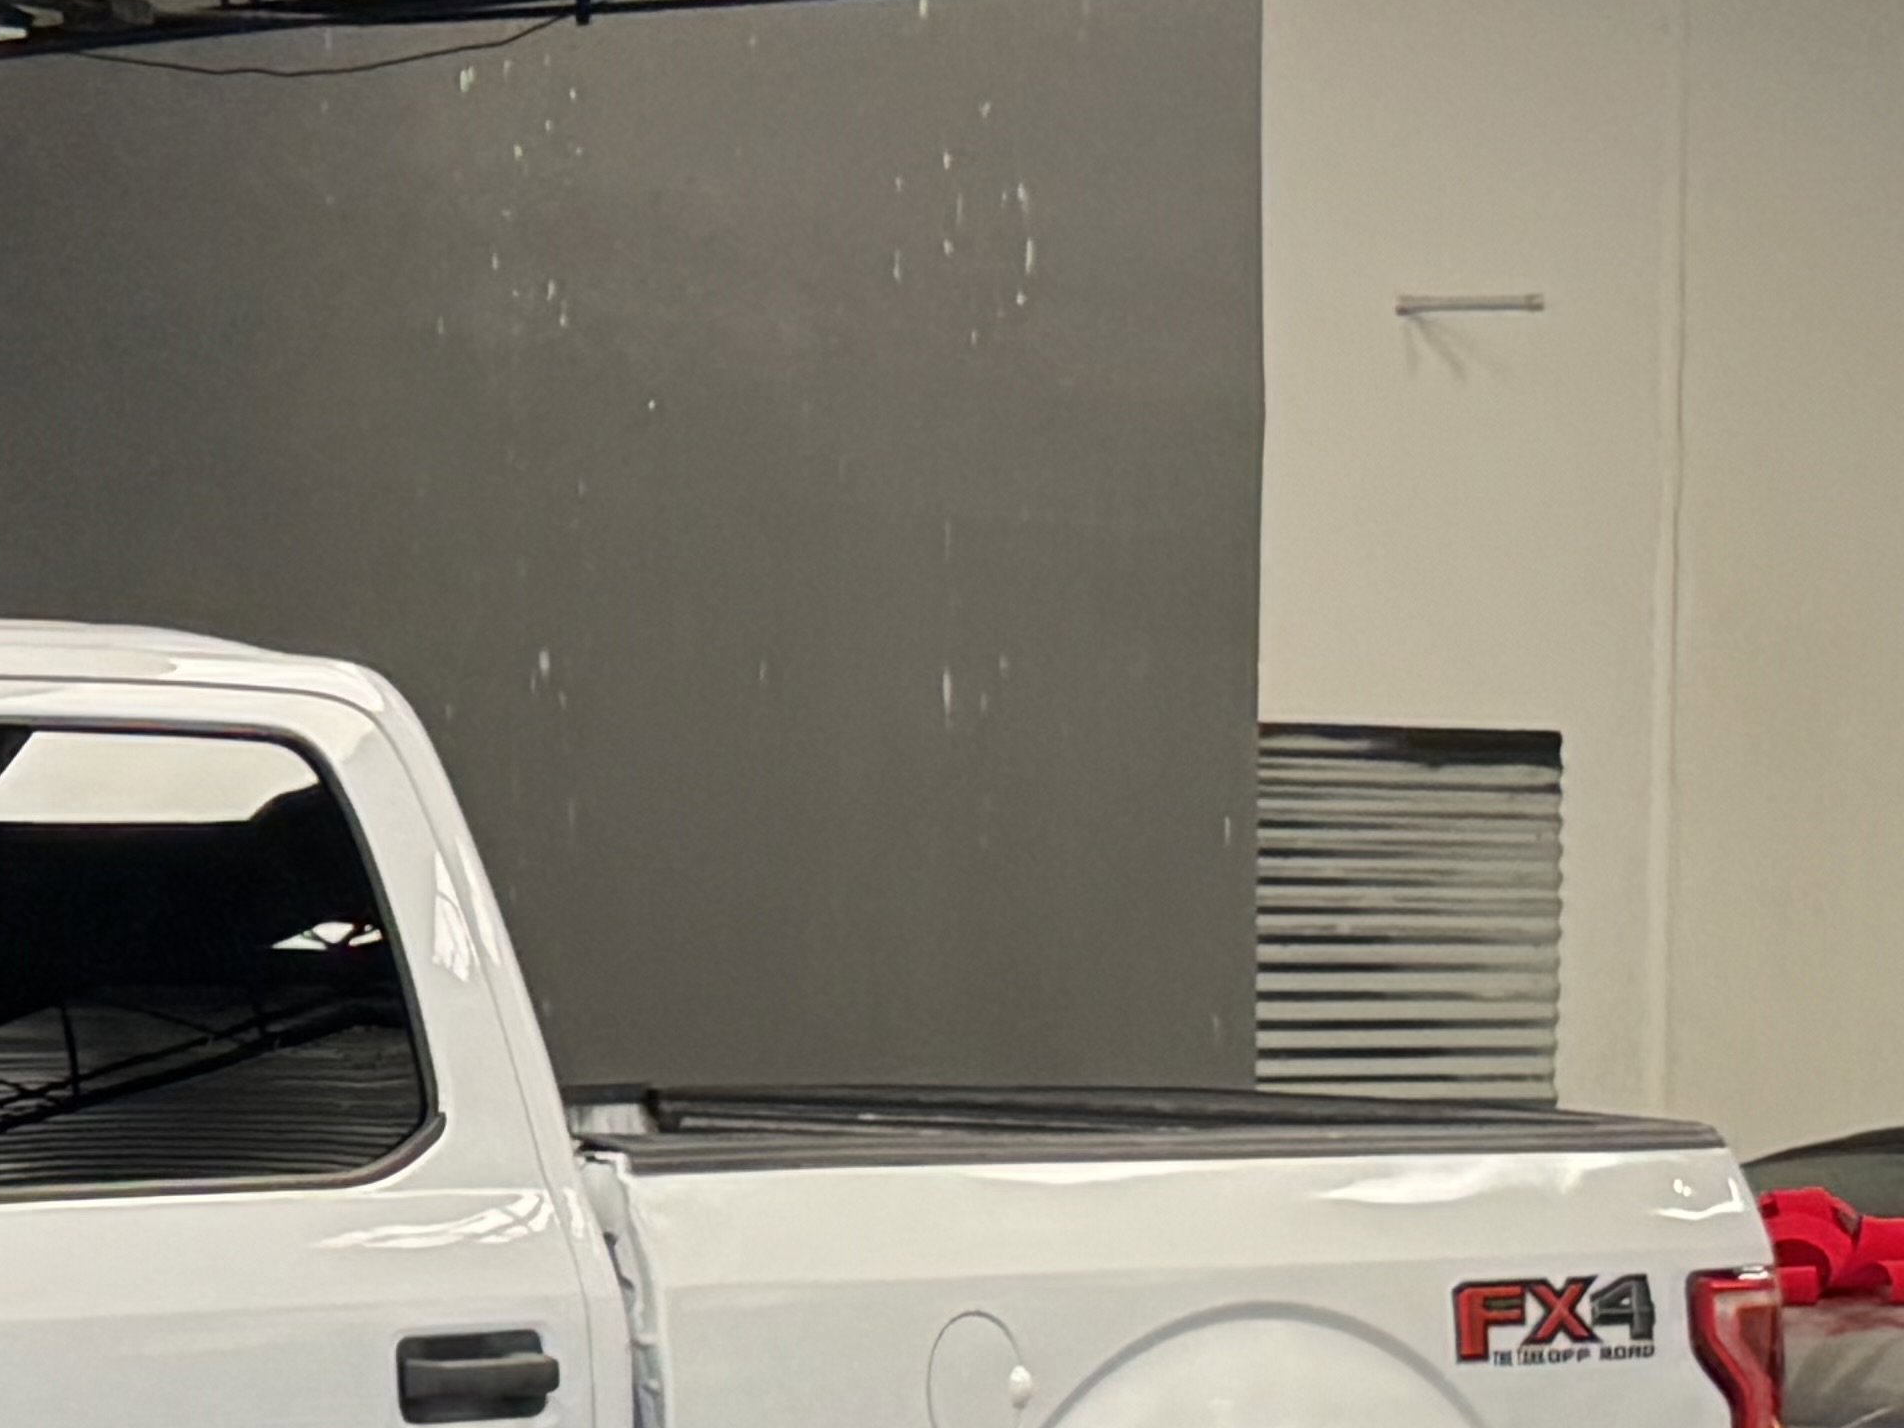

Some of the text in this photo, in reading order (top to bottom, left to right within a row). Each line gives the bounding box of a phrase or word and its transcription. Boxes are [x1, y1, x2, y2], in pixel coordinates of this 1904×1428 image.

[1452, 1273, 1655, 1363] FX4
[1547, 1347, 1591, 1364] OFF
[1599, 1345, 1655, 1360] ROAD
